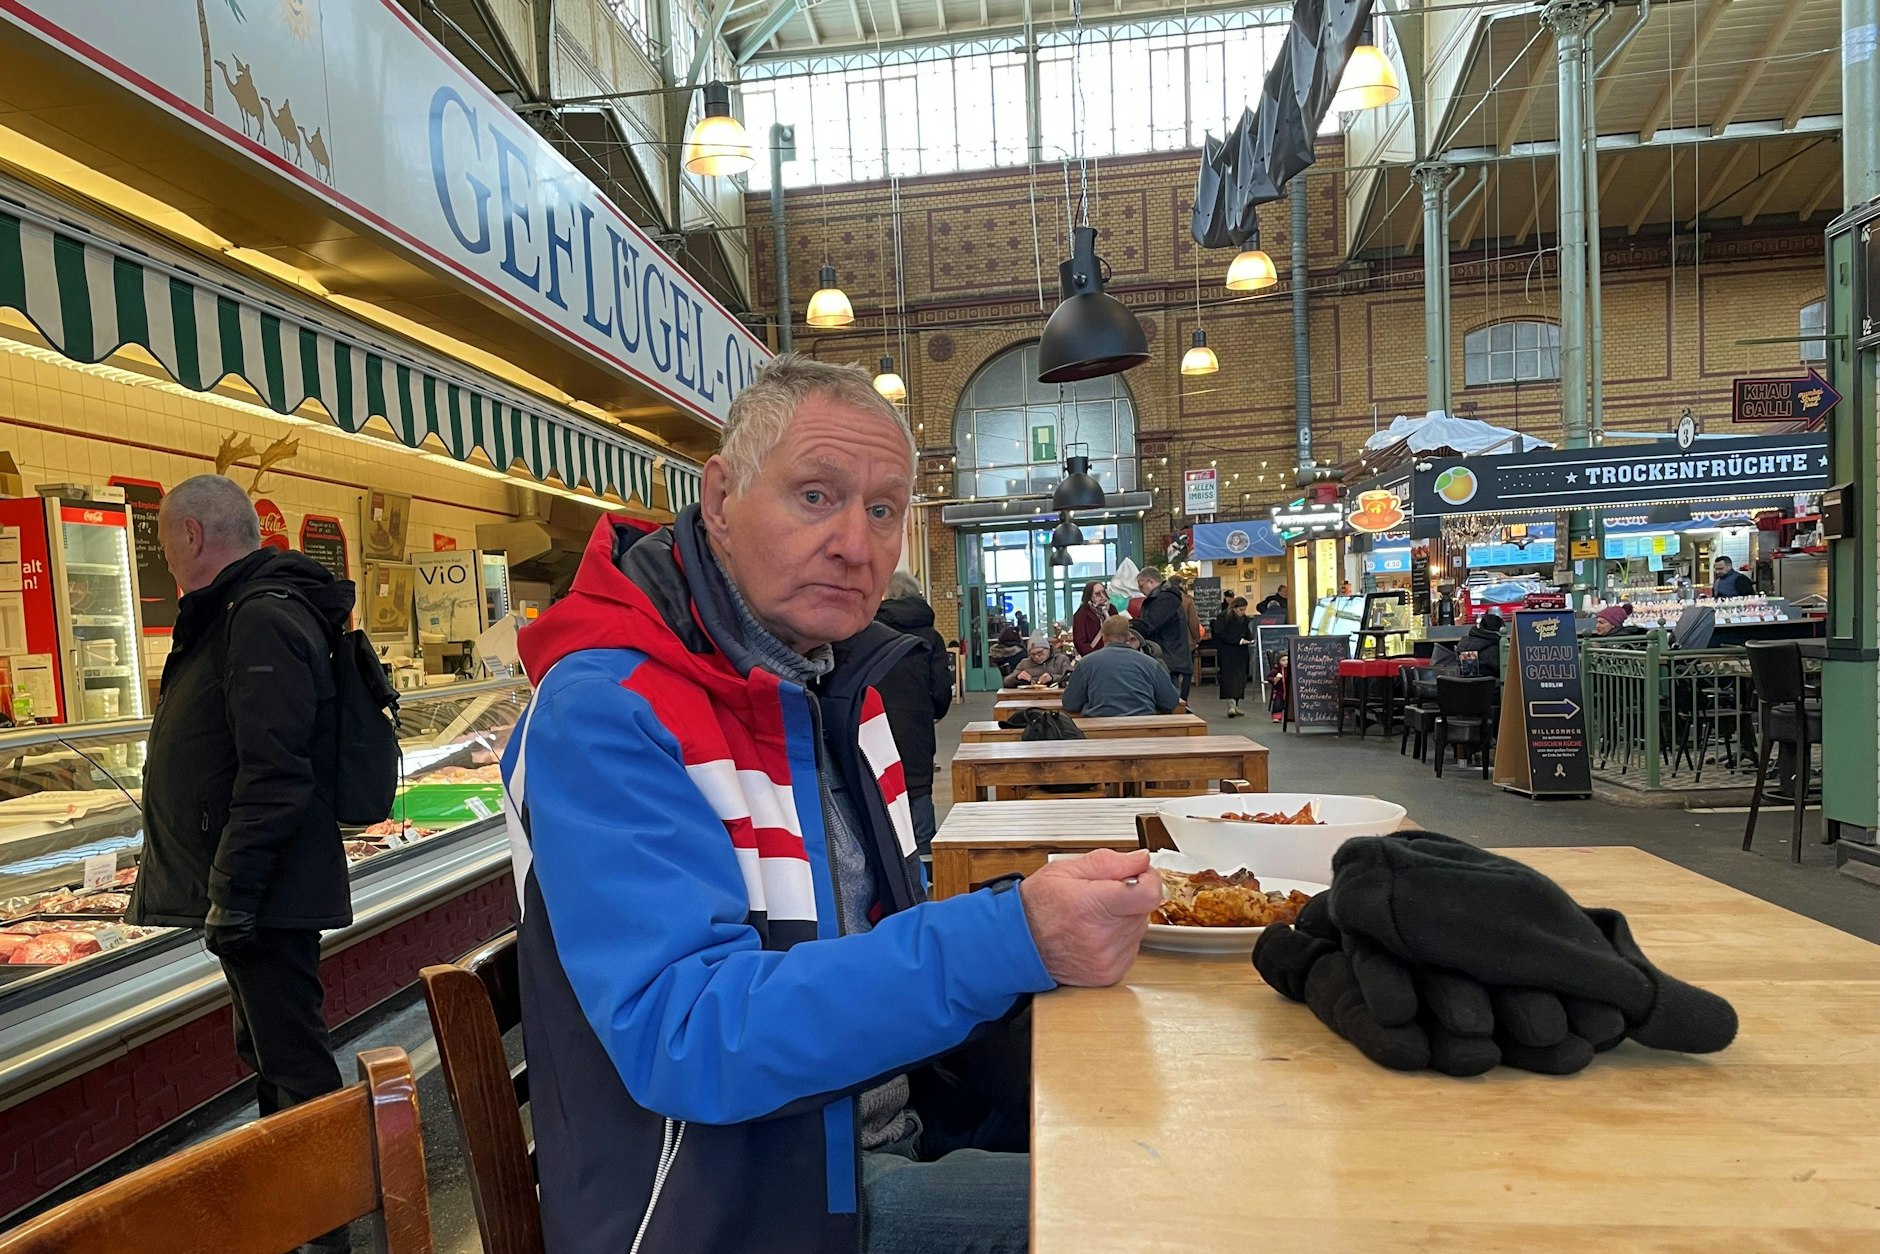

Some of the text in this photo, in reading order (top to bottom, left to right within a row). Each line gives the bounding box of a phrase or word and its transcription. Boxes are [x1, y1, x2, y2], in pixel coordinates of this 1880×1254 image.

[1744, 383, 1791, 400] KHAU
[1743, 401, 1793, 417] GALLI
[1683, 428, 1689, 445] 3
[1585, 454, 1808, 485] TROCKENFRÜCHTE
[1189, 491, 1214, 500] IMBISS
[22, 559, 43, 574] alt
[23, 575, 38, 590] n!
[419, 565, 466, 585] ViO
[1525, 645, 1573, 662] KHAU
[1525, 664, 1577, 680] GALLI
